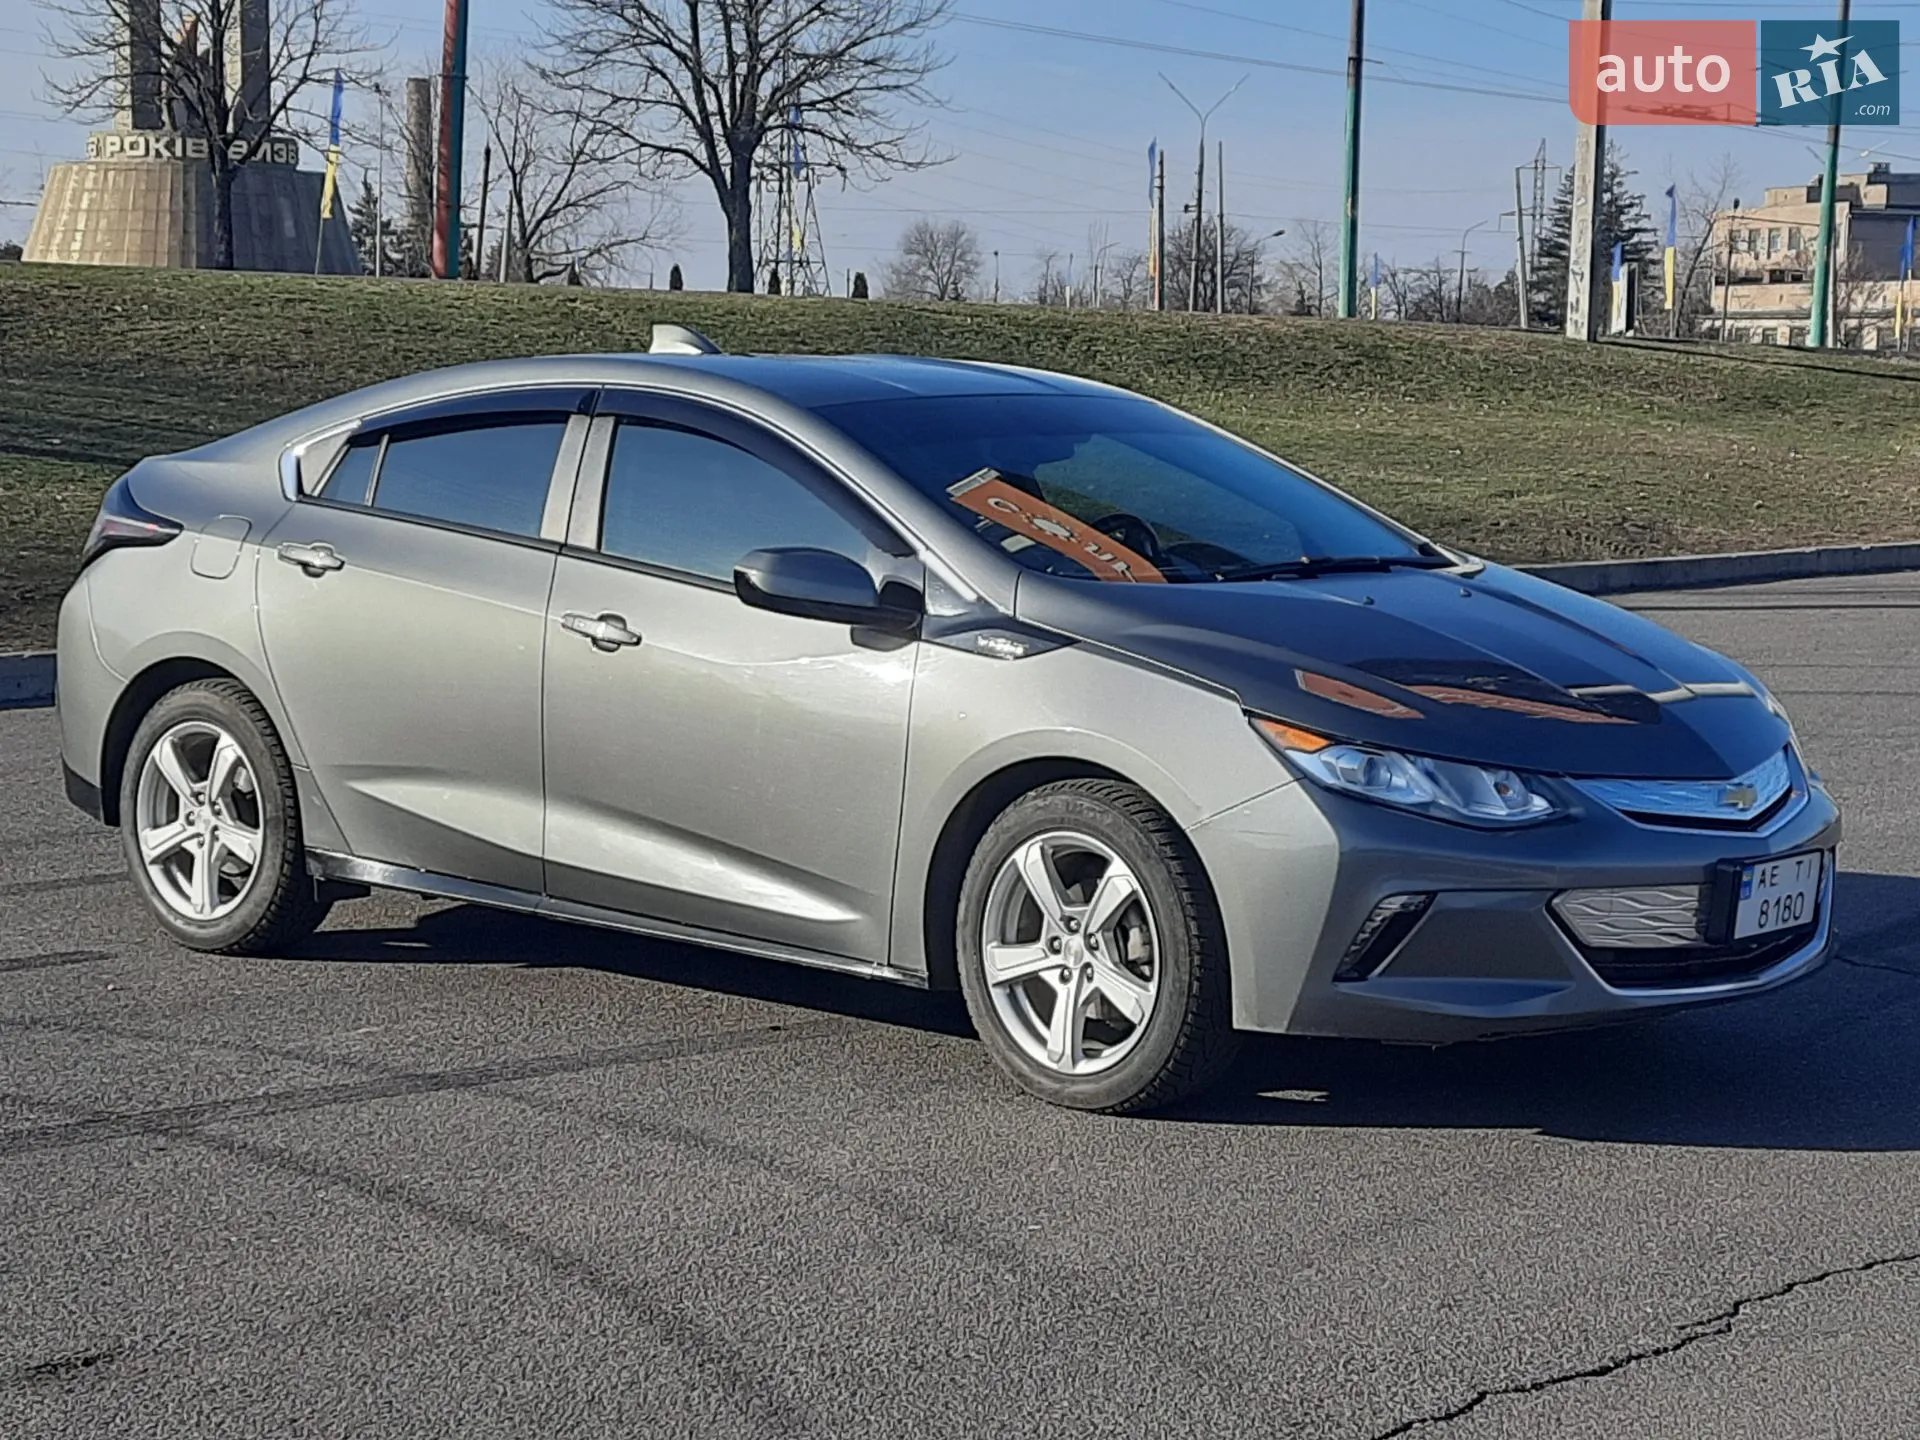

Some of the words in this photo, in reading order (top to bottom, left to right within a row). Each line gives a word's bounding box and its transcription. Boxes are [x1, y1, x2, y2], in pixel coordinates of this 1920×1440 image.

[105, 135, 209, 160] РОКІВ
[1757, 864, 1780, 889] AE
[1757, 890, 1805, 929] 8180
